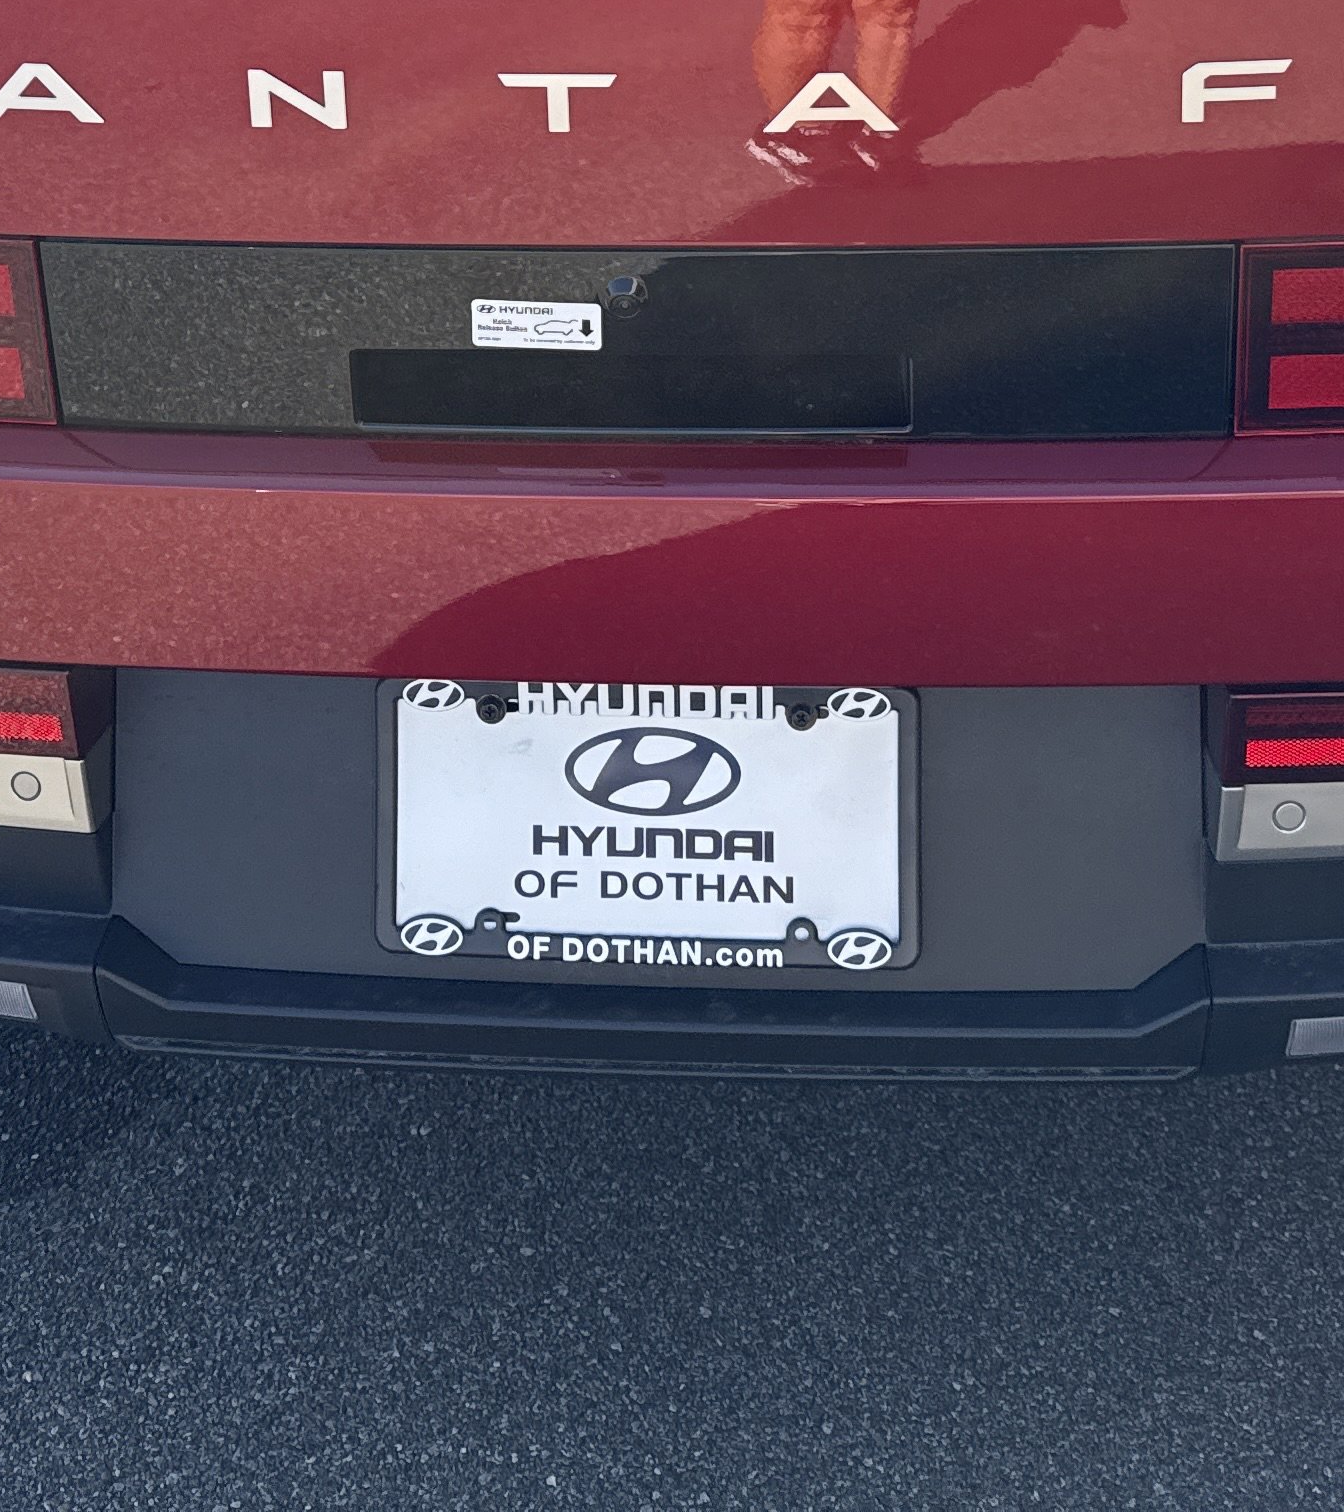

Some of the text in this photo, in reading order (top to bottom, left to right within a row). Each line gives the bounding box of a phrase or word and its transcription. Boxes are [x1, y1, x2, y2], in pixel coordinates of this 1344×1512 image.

[498, 305, 554, 316] HYUNDAI
[517, 681, 775, 720] HYUNDAI
[531, 824, 775, 863] HYUNDAI
[513, 869, 795, 904] OF DOTHAN
[506, 934, 784, 969] OF DOTHAN.com
